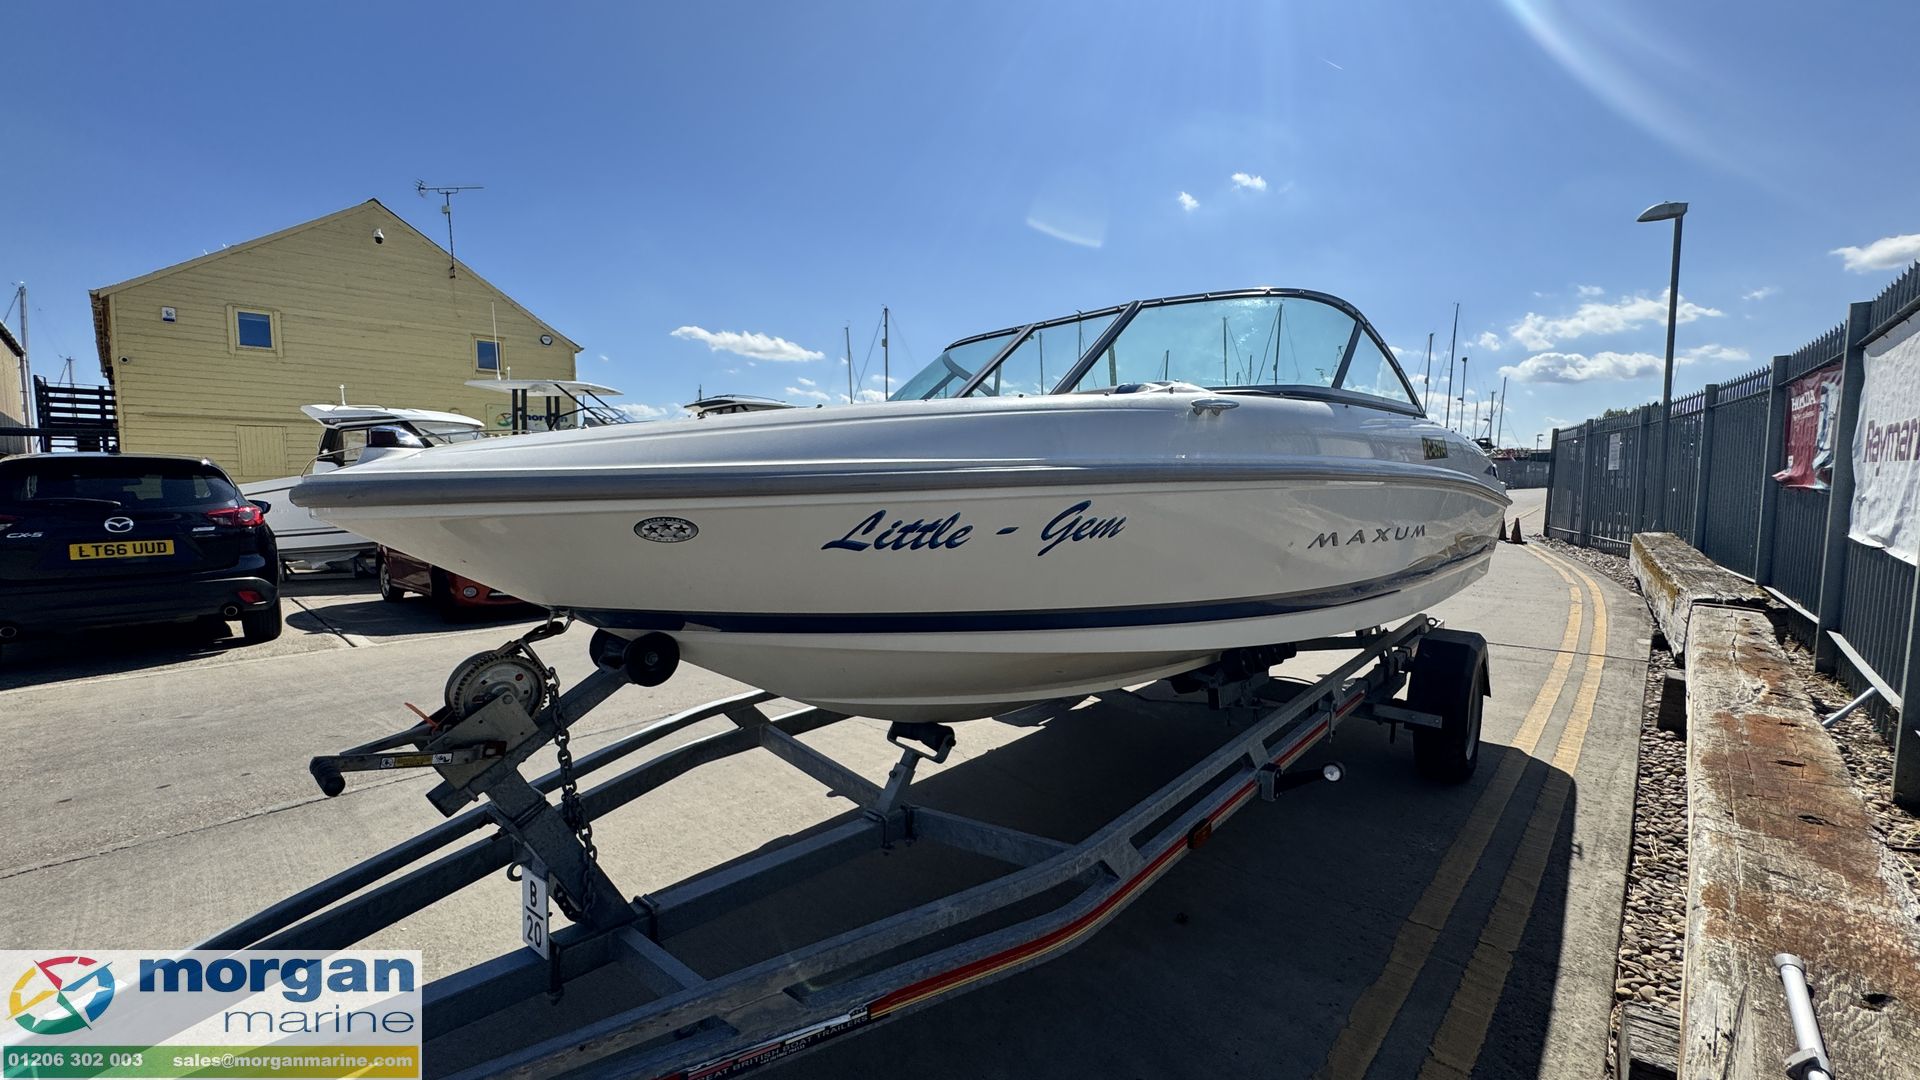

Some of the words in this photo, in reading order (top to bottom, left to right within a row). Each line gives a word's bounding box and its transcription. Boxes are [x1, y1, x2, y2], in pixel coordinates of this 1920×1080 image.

[6, 531, 44, 539] CX-5
[820, 509, 974, 552] Little
[1037, 499, 1127, 557] Gem
[1307, 524, 1426, 550] MAXUM
[78, 542, 128, 558] LT66
[132, 541, 168, 555] UUD
[529, 879, 538, 908] B
[526, 914, 542, 948] 20
[782, 1036, 813, 1052] BOAT
[816, 1016, 868, 1038] TRAILERS
